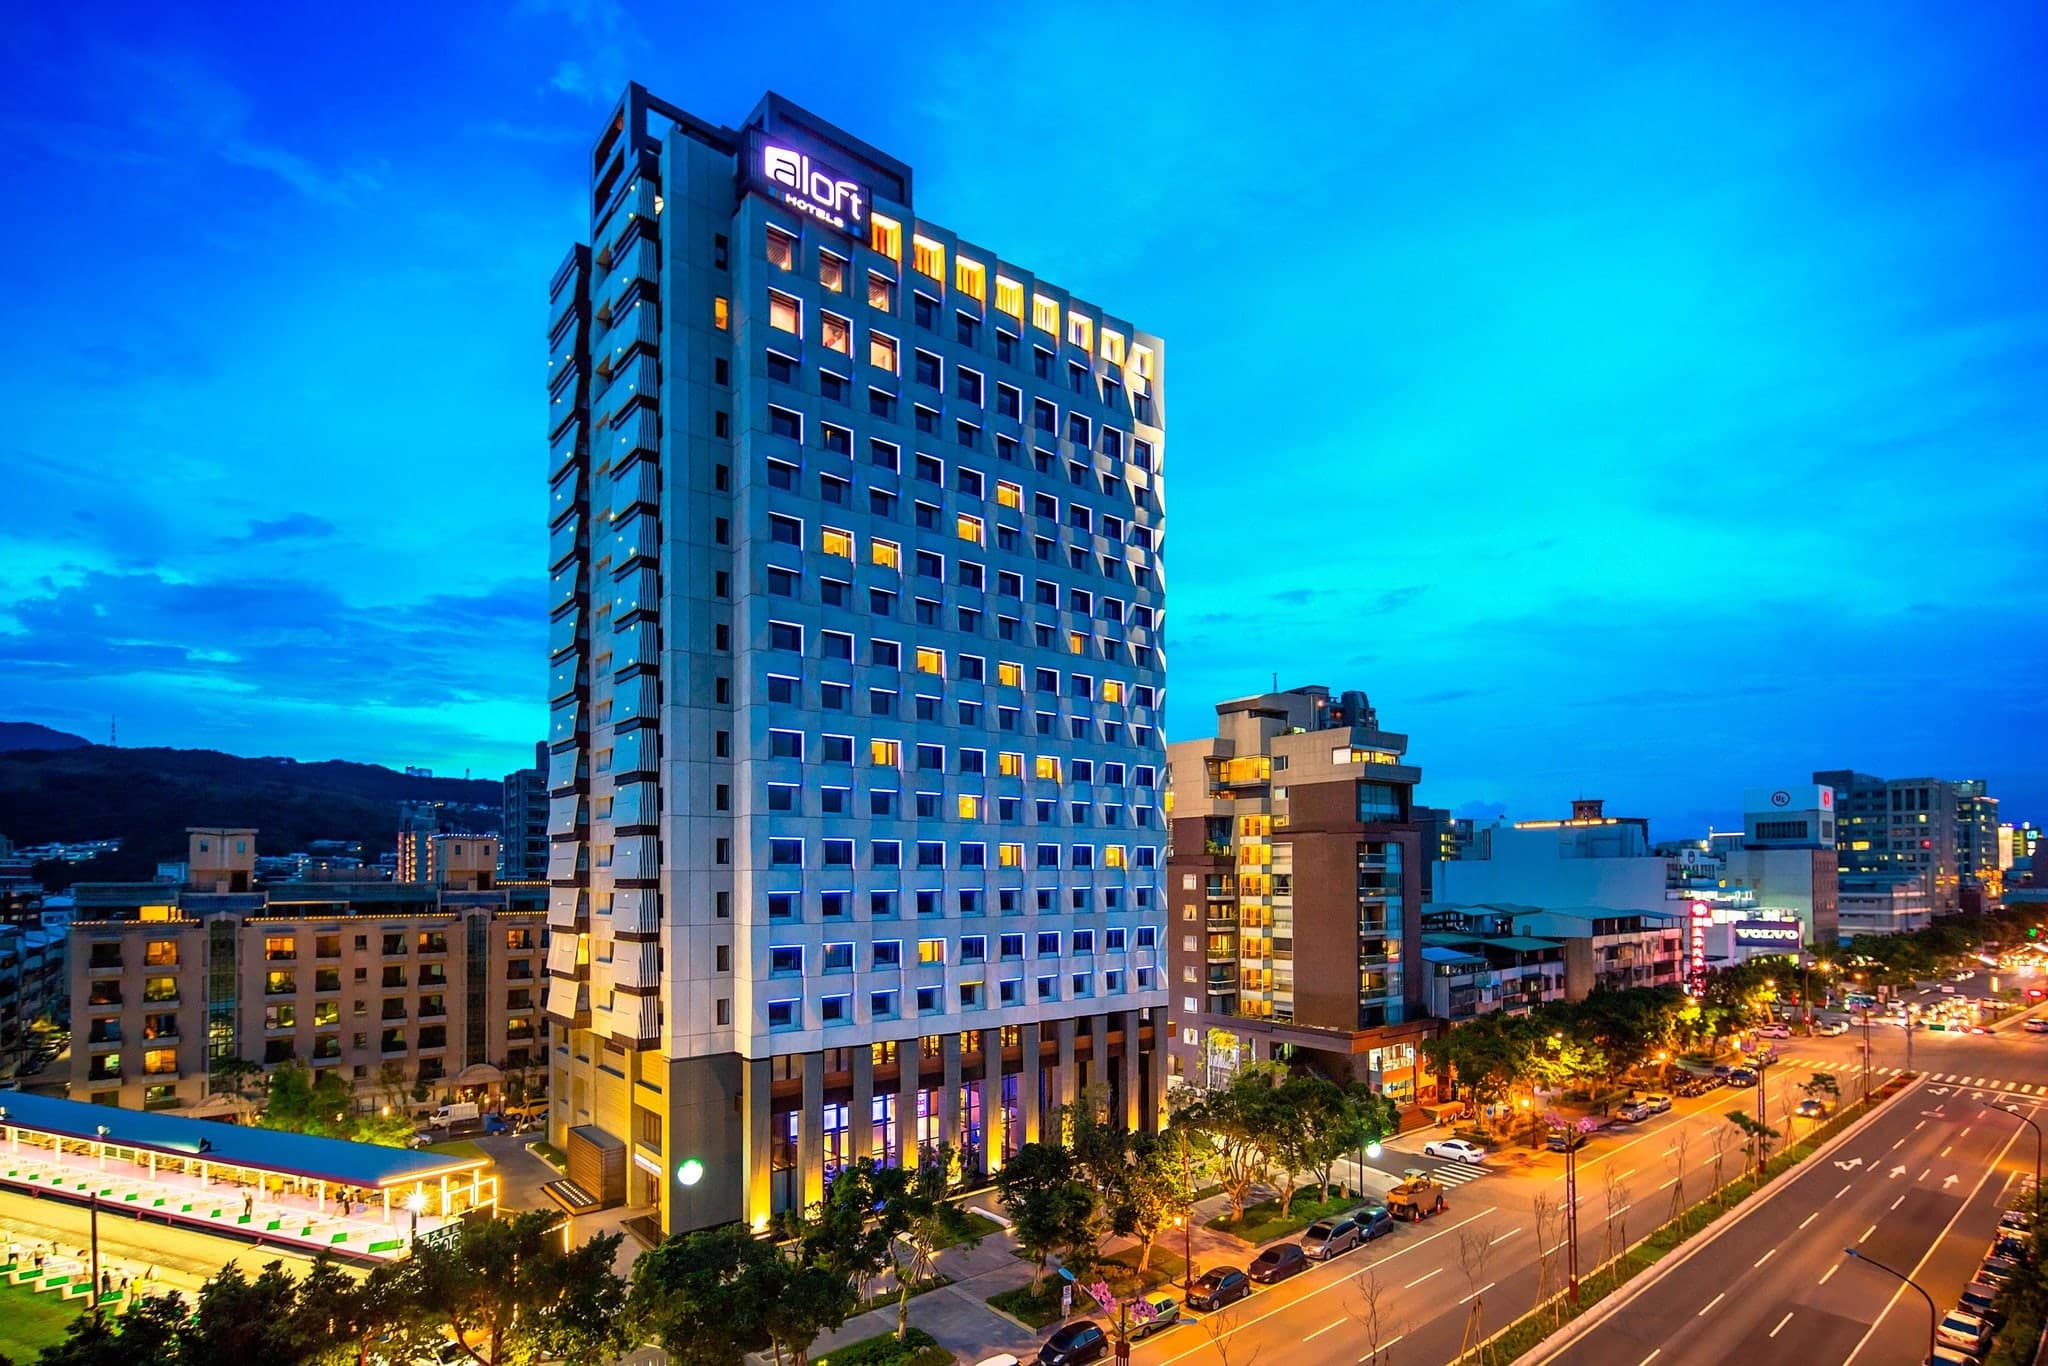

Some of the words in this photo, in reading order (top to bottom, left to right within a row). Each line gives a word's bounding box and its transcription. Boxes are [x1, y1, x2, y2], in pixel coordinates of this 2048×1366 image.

[765, 145, 862, 220] aloft
[785, 193, 844, 228] HOTELS
[1736, 928, 1799, 940] VOLVO
